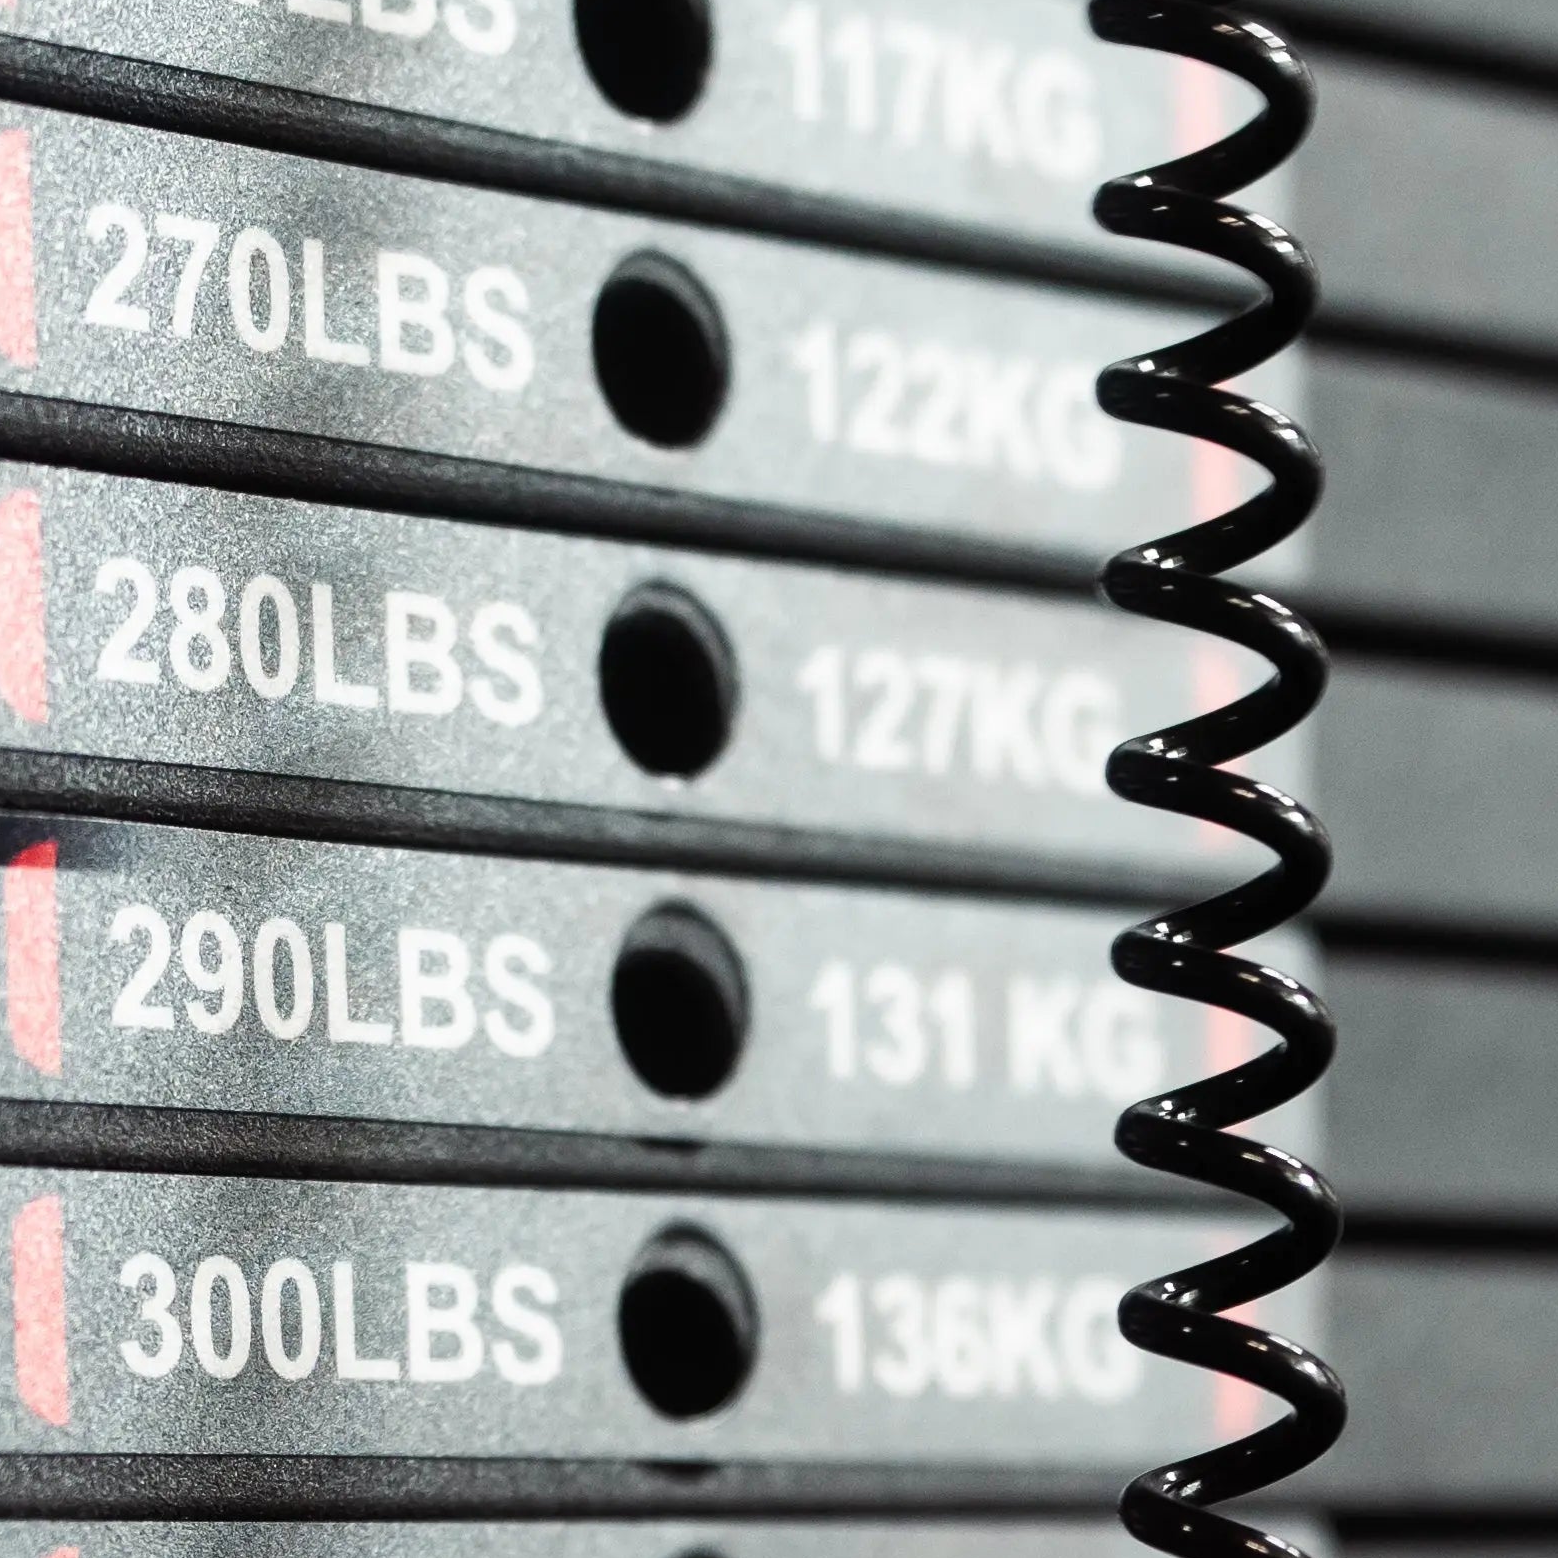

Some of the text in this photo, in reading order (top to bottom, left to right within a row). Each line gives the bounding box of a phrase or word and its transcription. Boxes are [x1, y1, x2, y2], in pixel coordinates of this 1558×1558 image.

[777, 1, 1103, 180] 117KG
[84, 204, 1125, 491] 270LBS 122KG
[92, 557, 1123, 797] 280LBS 127KG
[109, 903, 1168, 1103] 290LBS 131 KG
[117, 1252, 1145, 1405] 300LBS 136KG
